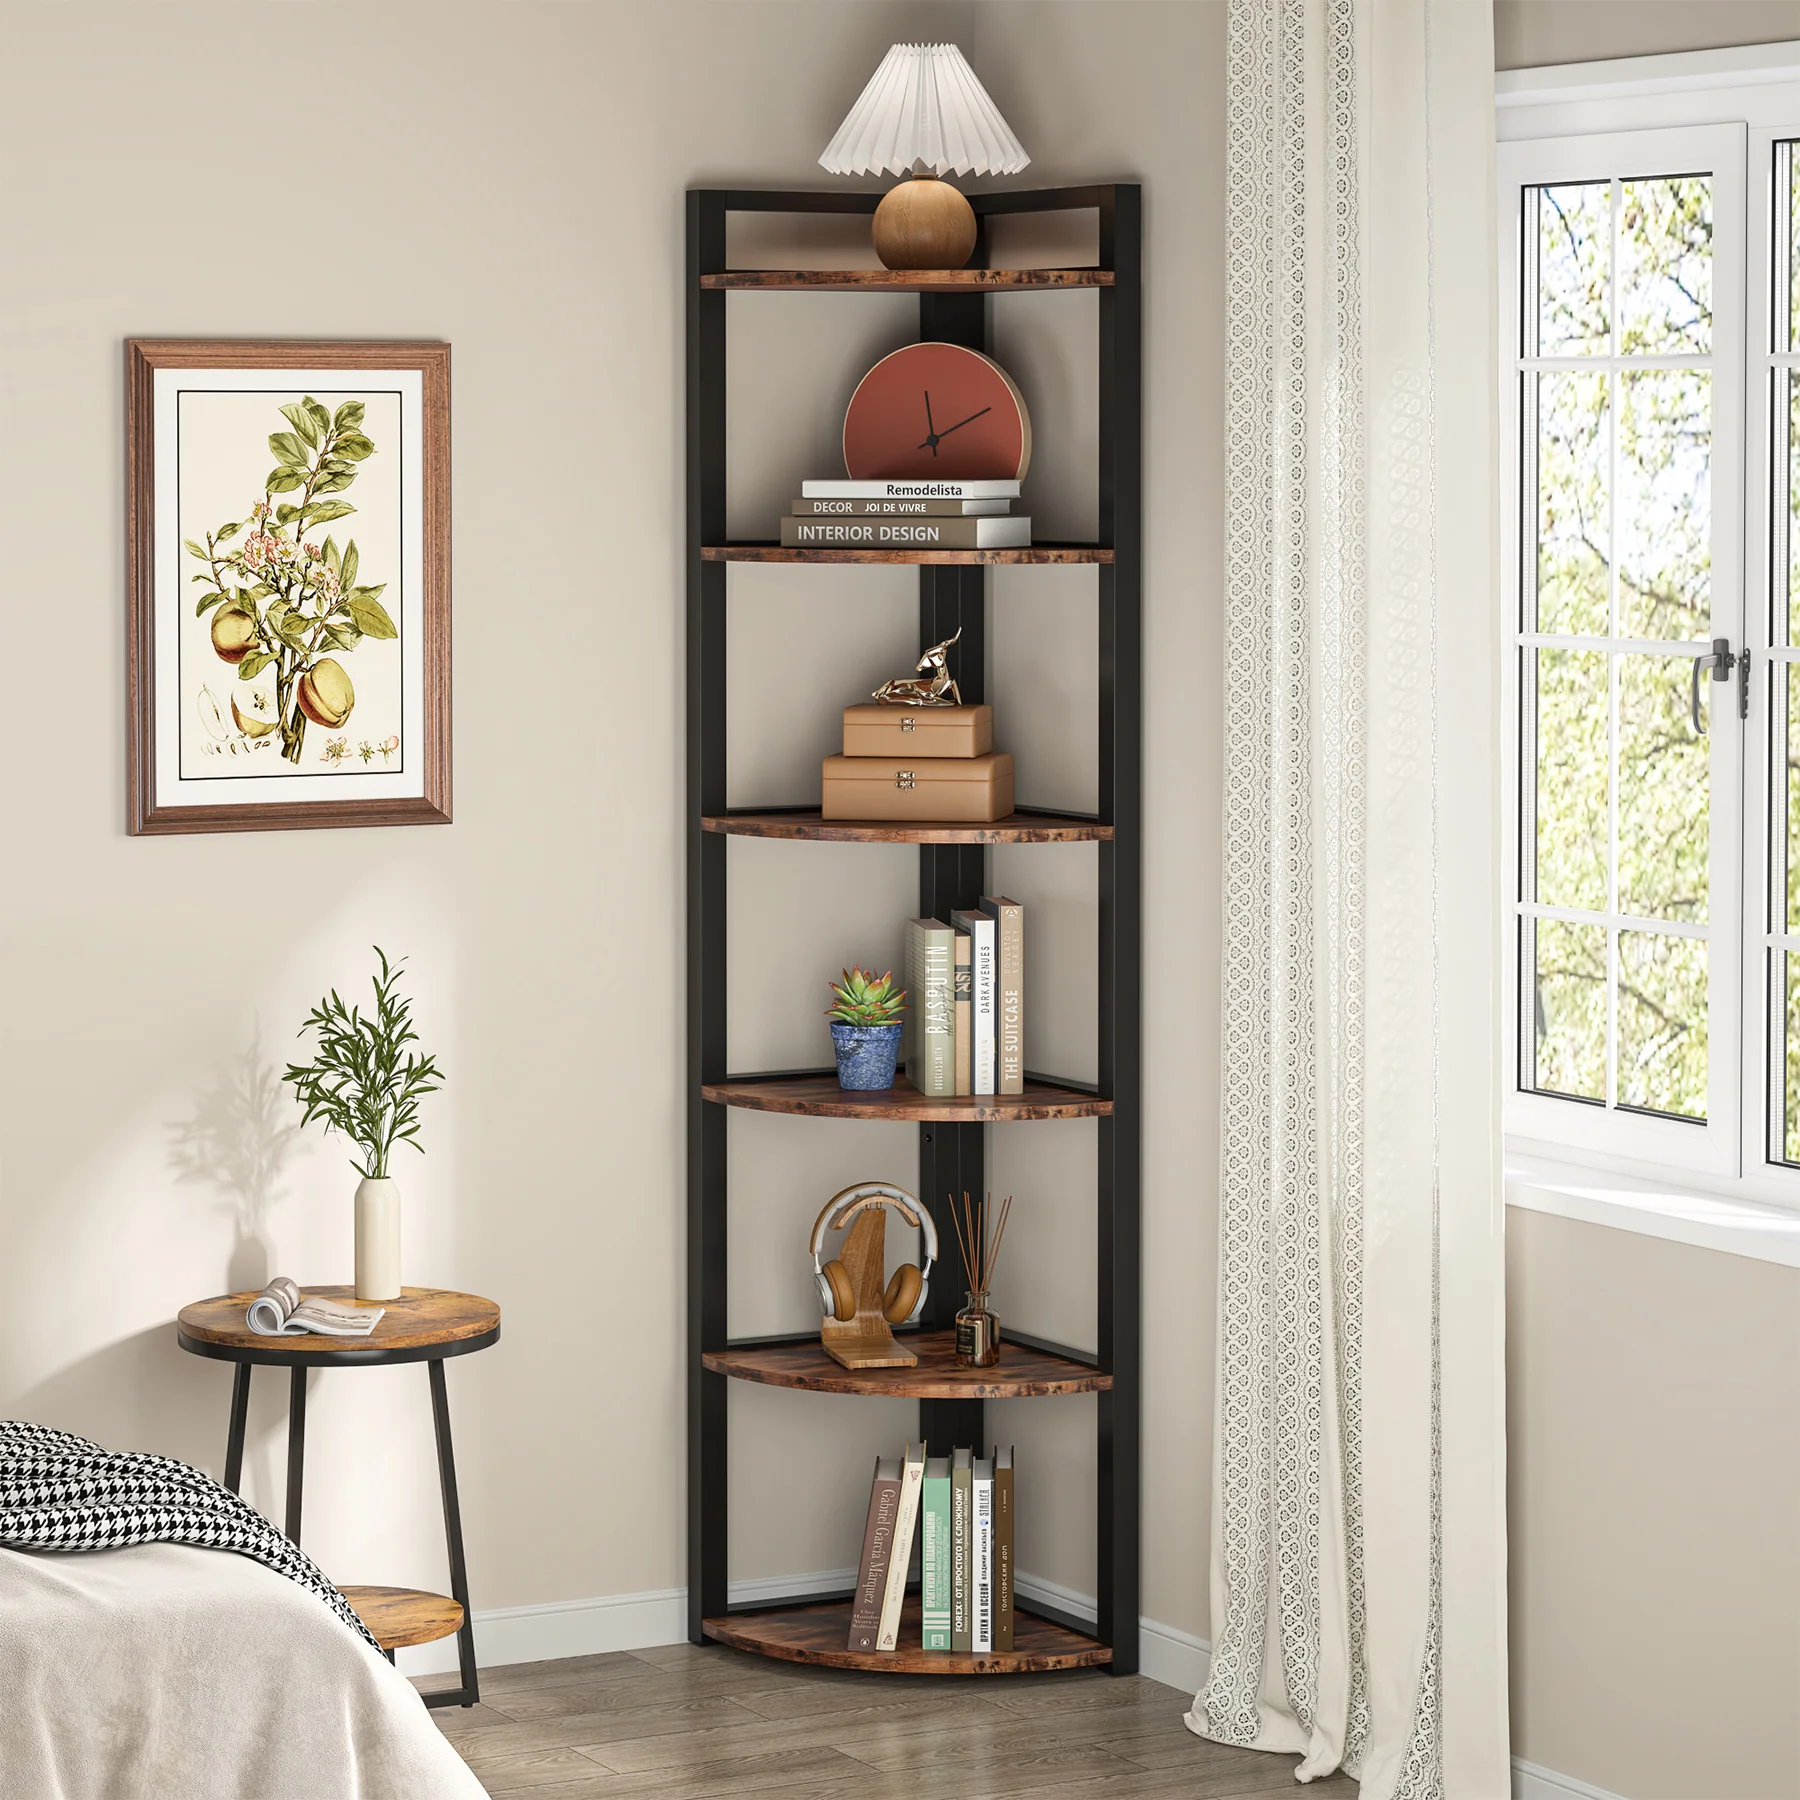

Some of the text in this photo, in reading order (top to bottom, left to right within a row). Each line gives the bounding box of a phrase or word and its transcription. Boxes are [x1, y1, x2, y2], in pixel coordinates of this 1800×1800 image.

[886, 484, 962, 496] Remodelista
[813, 501, 853, 513] DECOR
[864, 503, 927, 513] JOI DE VIVRE
[798, 525, 940, 541] INTERIOR DESIGN
[980, 945, 990, 1014] DARK AVENUES
[1005, 990, 1018, 1081] THE SUITCASE
[862, 1488, 896, 1604] Gabriel García Márquez
[956, 1587, 963, 1599] ОТ
[980, 1608, 989, 1617] НА
[980, 1619, 989, 1643] ПРЯТКИ
